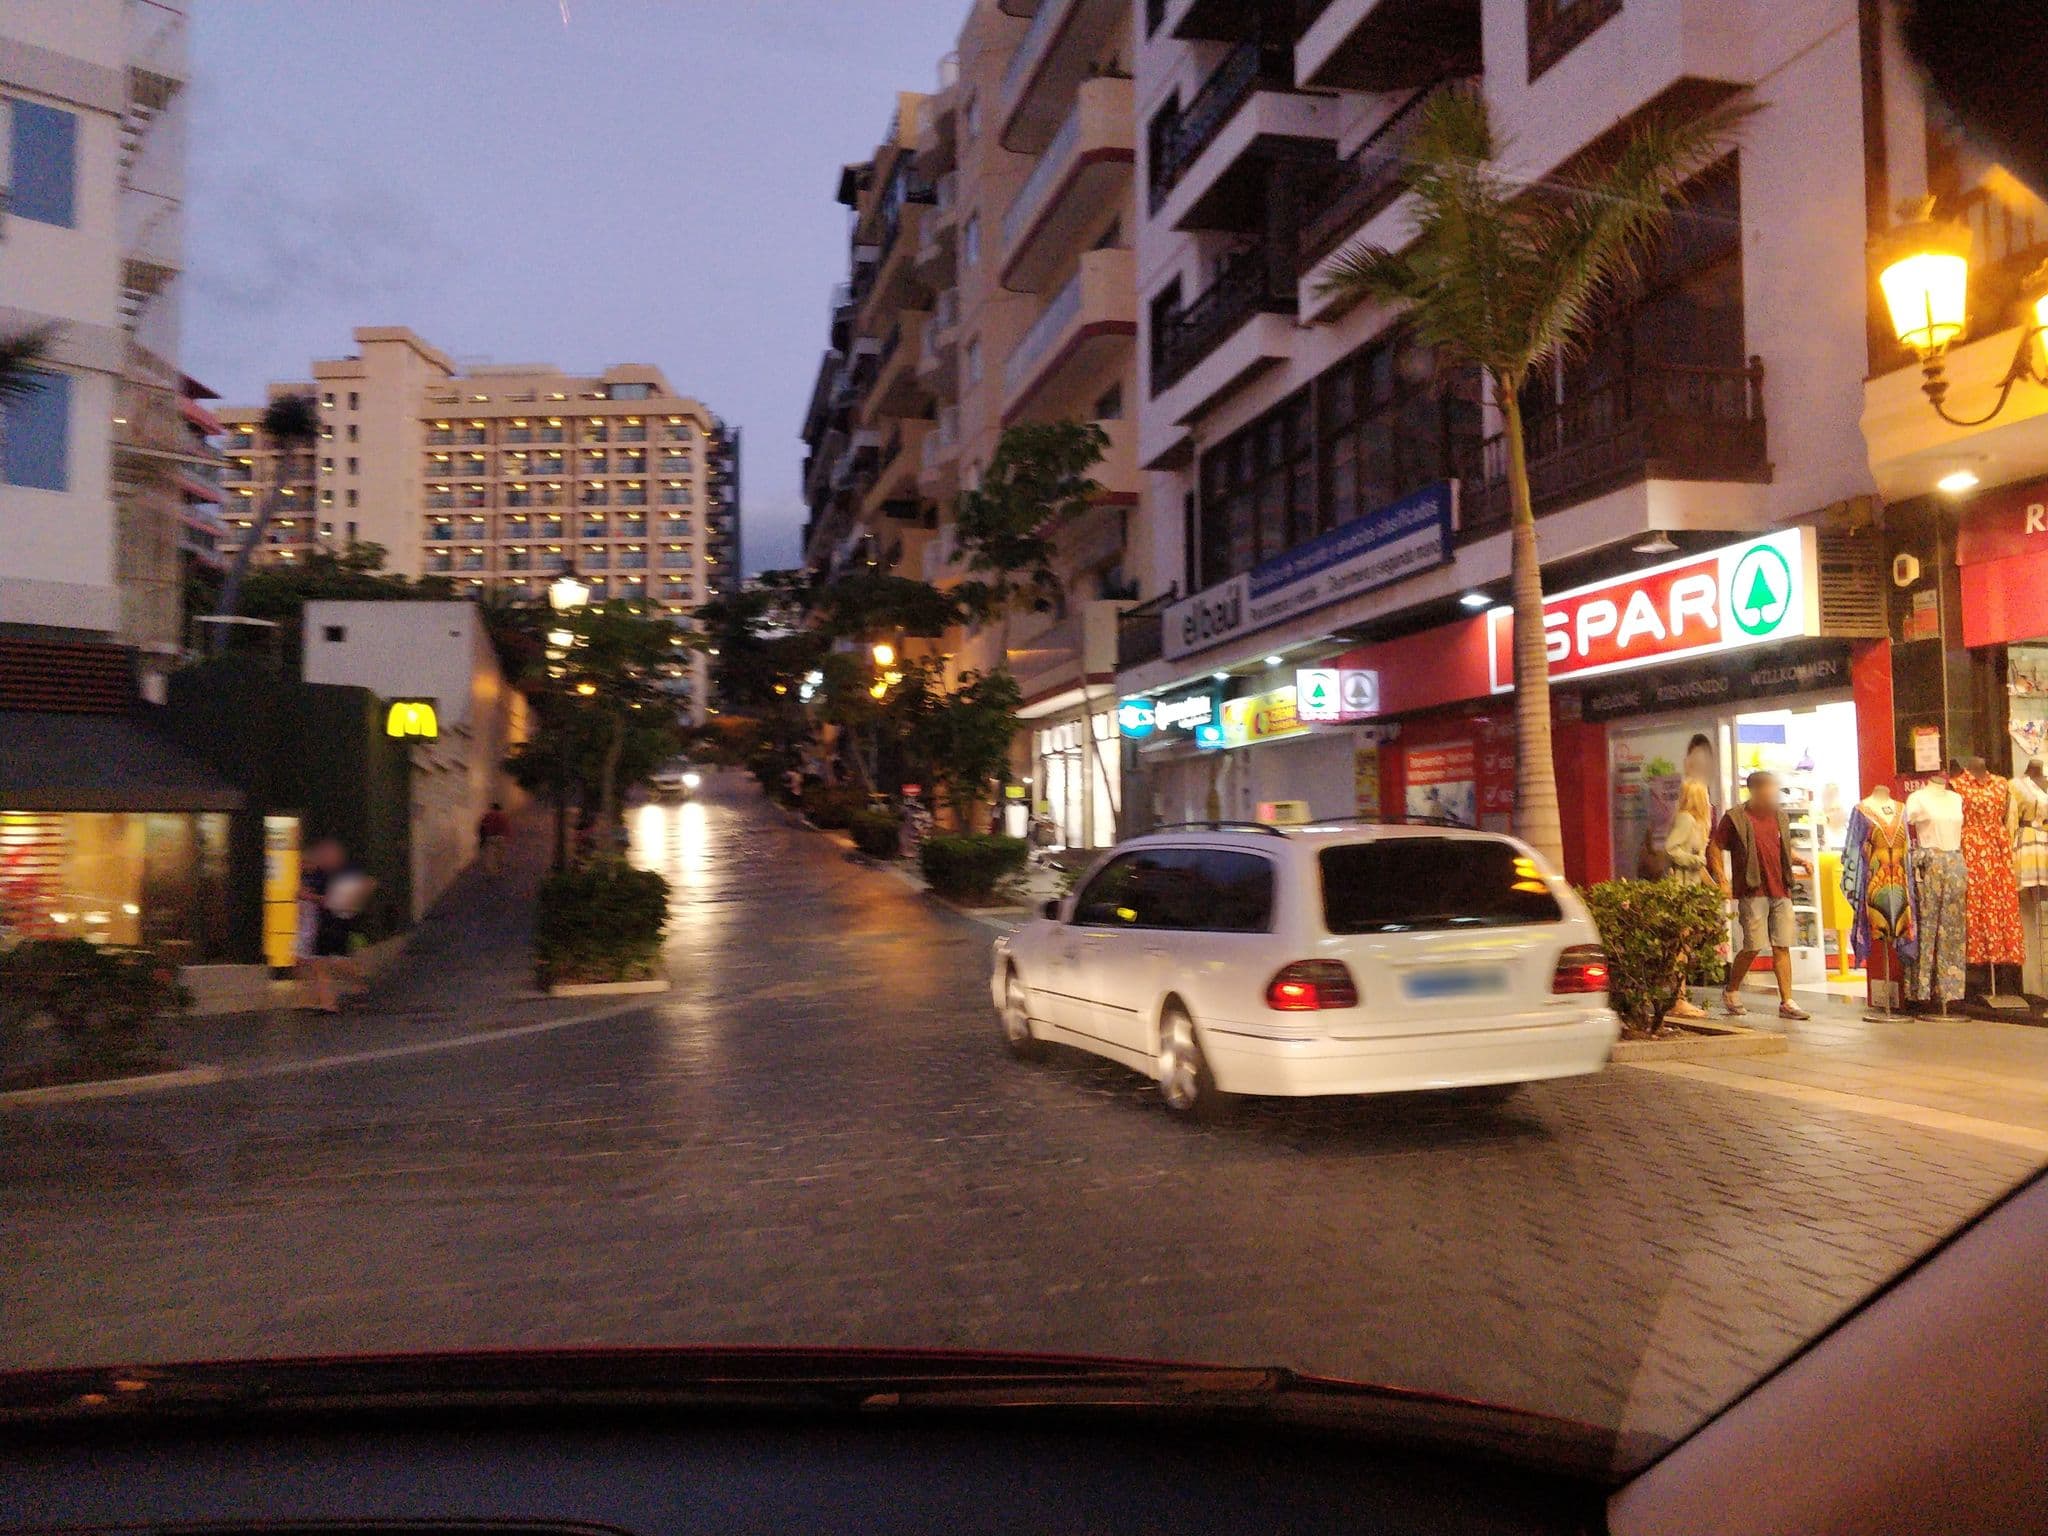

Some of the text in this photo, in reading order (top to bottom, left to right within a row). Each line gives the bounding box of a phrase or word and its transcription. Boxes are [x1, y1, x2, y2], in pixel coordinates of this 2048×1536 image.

[1543, 573, 1718, 663] SPAR
[1750, 659, 1837, 686] WILLKOMMEN
[1904, 779, 1926, 793] REBA
